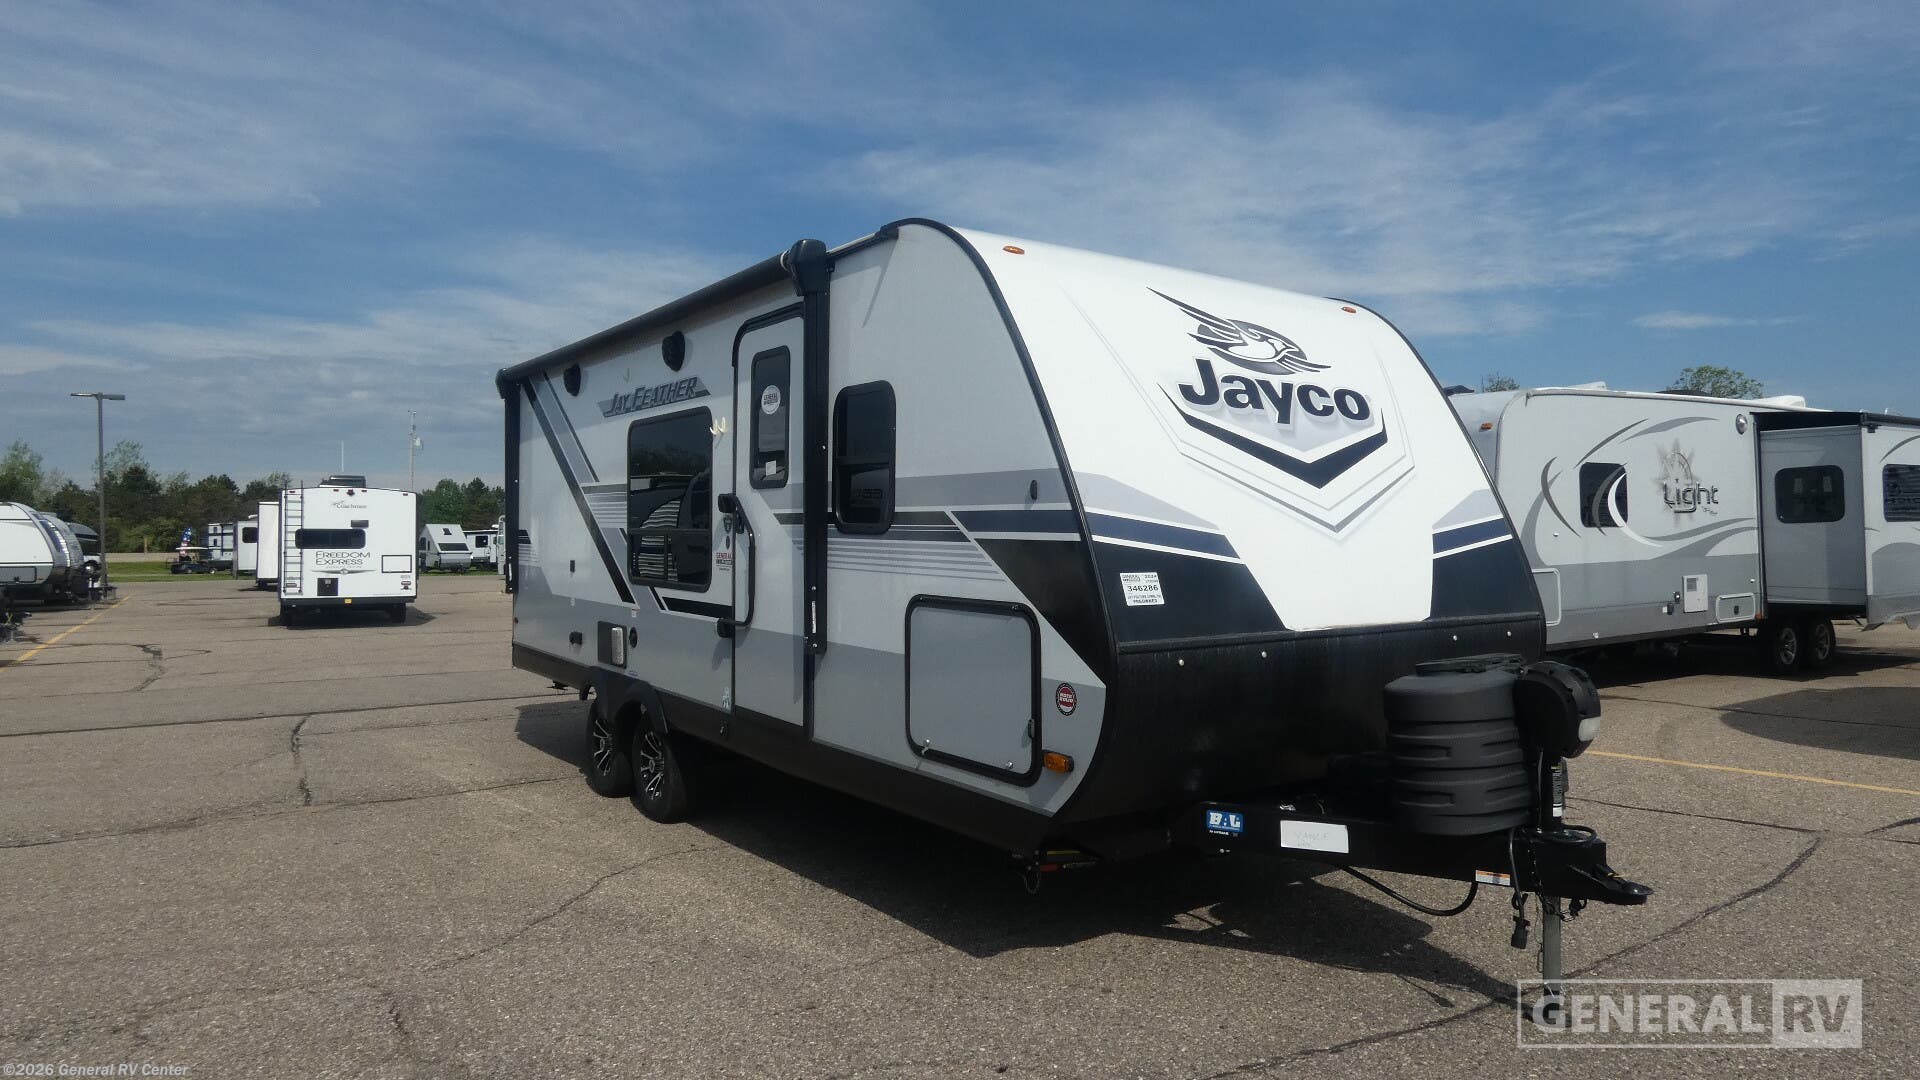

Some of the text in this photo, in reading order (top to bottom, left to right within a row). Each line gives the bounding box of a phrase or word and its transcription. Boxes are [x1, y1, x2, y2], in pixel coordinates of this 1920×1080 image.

[1178, 358, 1371, 425] Jayco
[1663, 480, 1719, 514] Light
[315, 550, 371, 559] FREEDOM
[315, 558, 364, 566] EXPRESS
[1127, 584, 1159, 592] 346286
